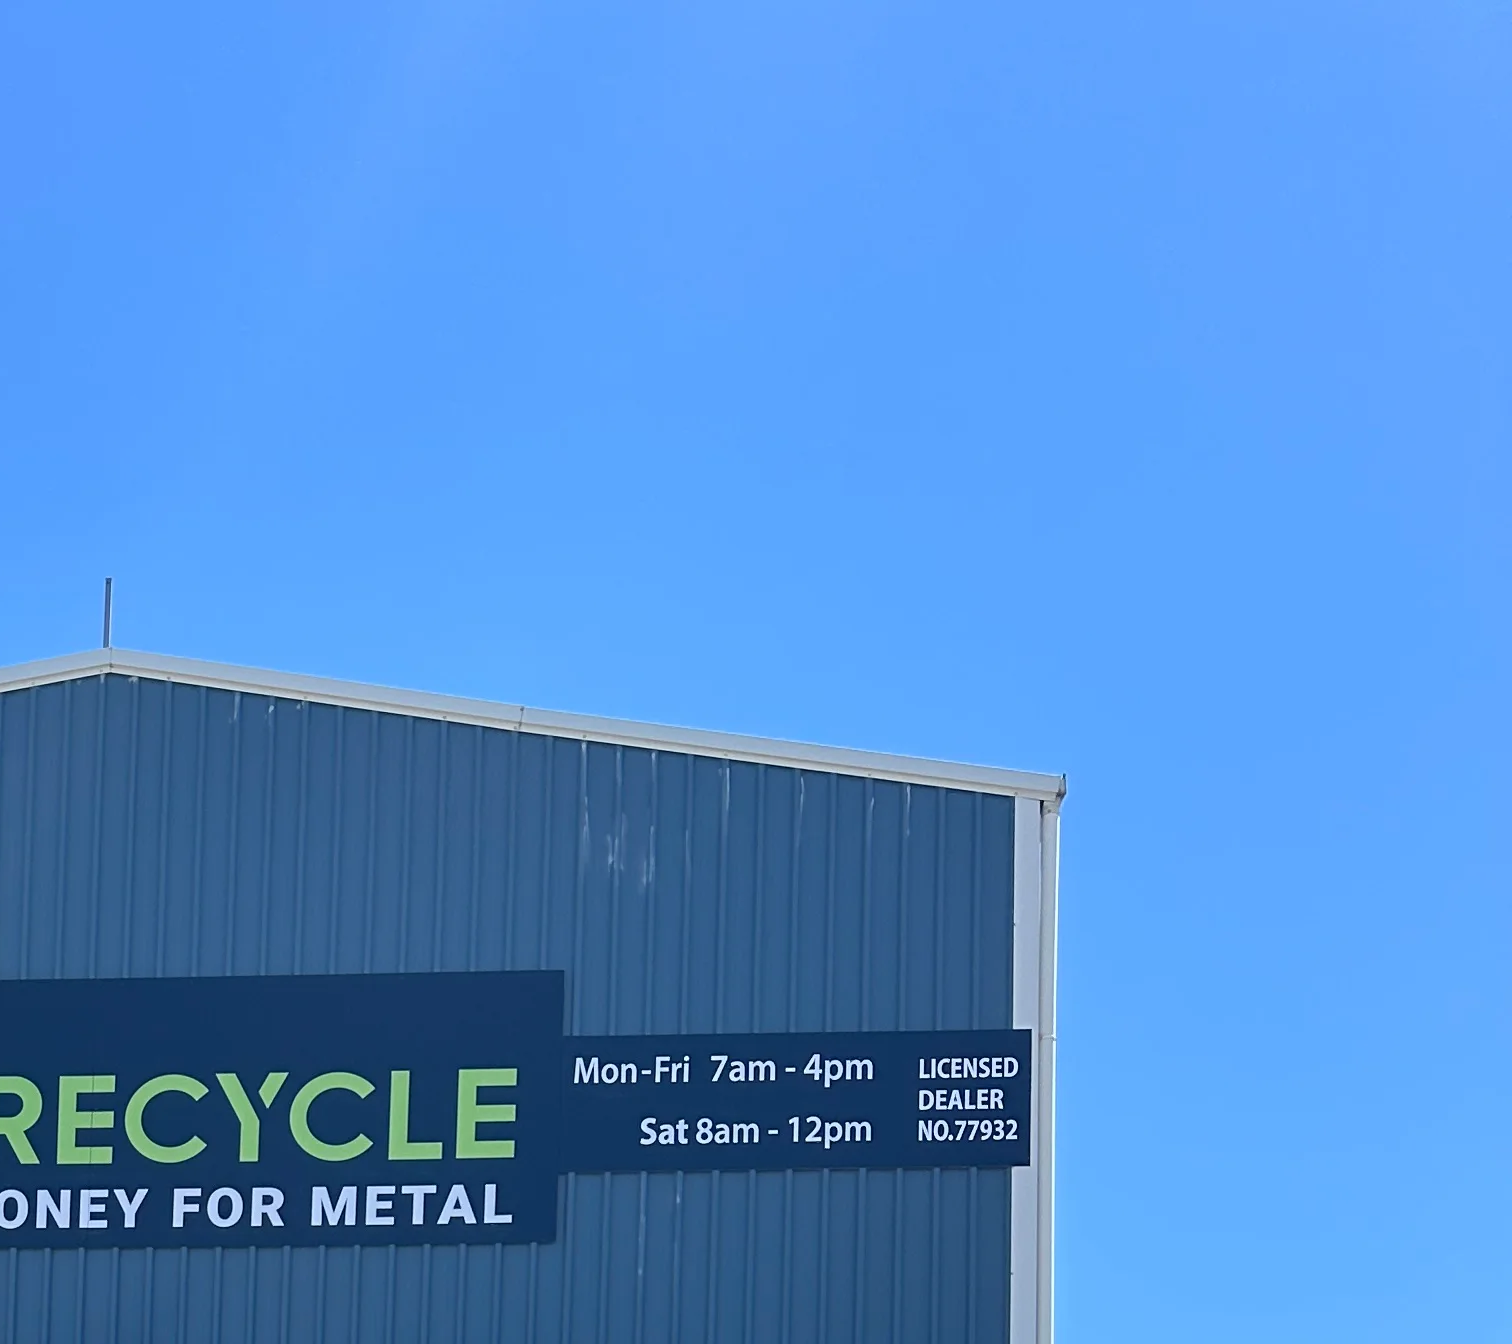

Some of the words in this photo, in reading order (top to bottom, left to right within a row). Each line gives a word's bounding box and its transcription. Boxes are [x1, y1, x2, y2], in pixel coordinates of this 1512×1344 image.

[573, 1055, 690, 1084] Mon-Fri
[710, 1055, 776, 1082] 7am
[803, 1053, 874, 1088] 4pm
[919, 1056, 1019, 1079] LICENSED
[918, 1088, 1004, 1111] DEALER
[639, 1117, 689, 1146] Sat
[695, 1117, 760, 1145] 8am
[788, 1115, 872, 1150] 12pm
[918, 1119, 1018, 1142] NO.77932
[172, 1187, 285, 1228] FOR
[310, 1184, 513, 1227] METAL
